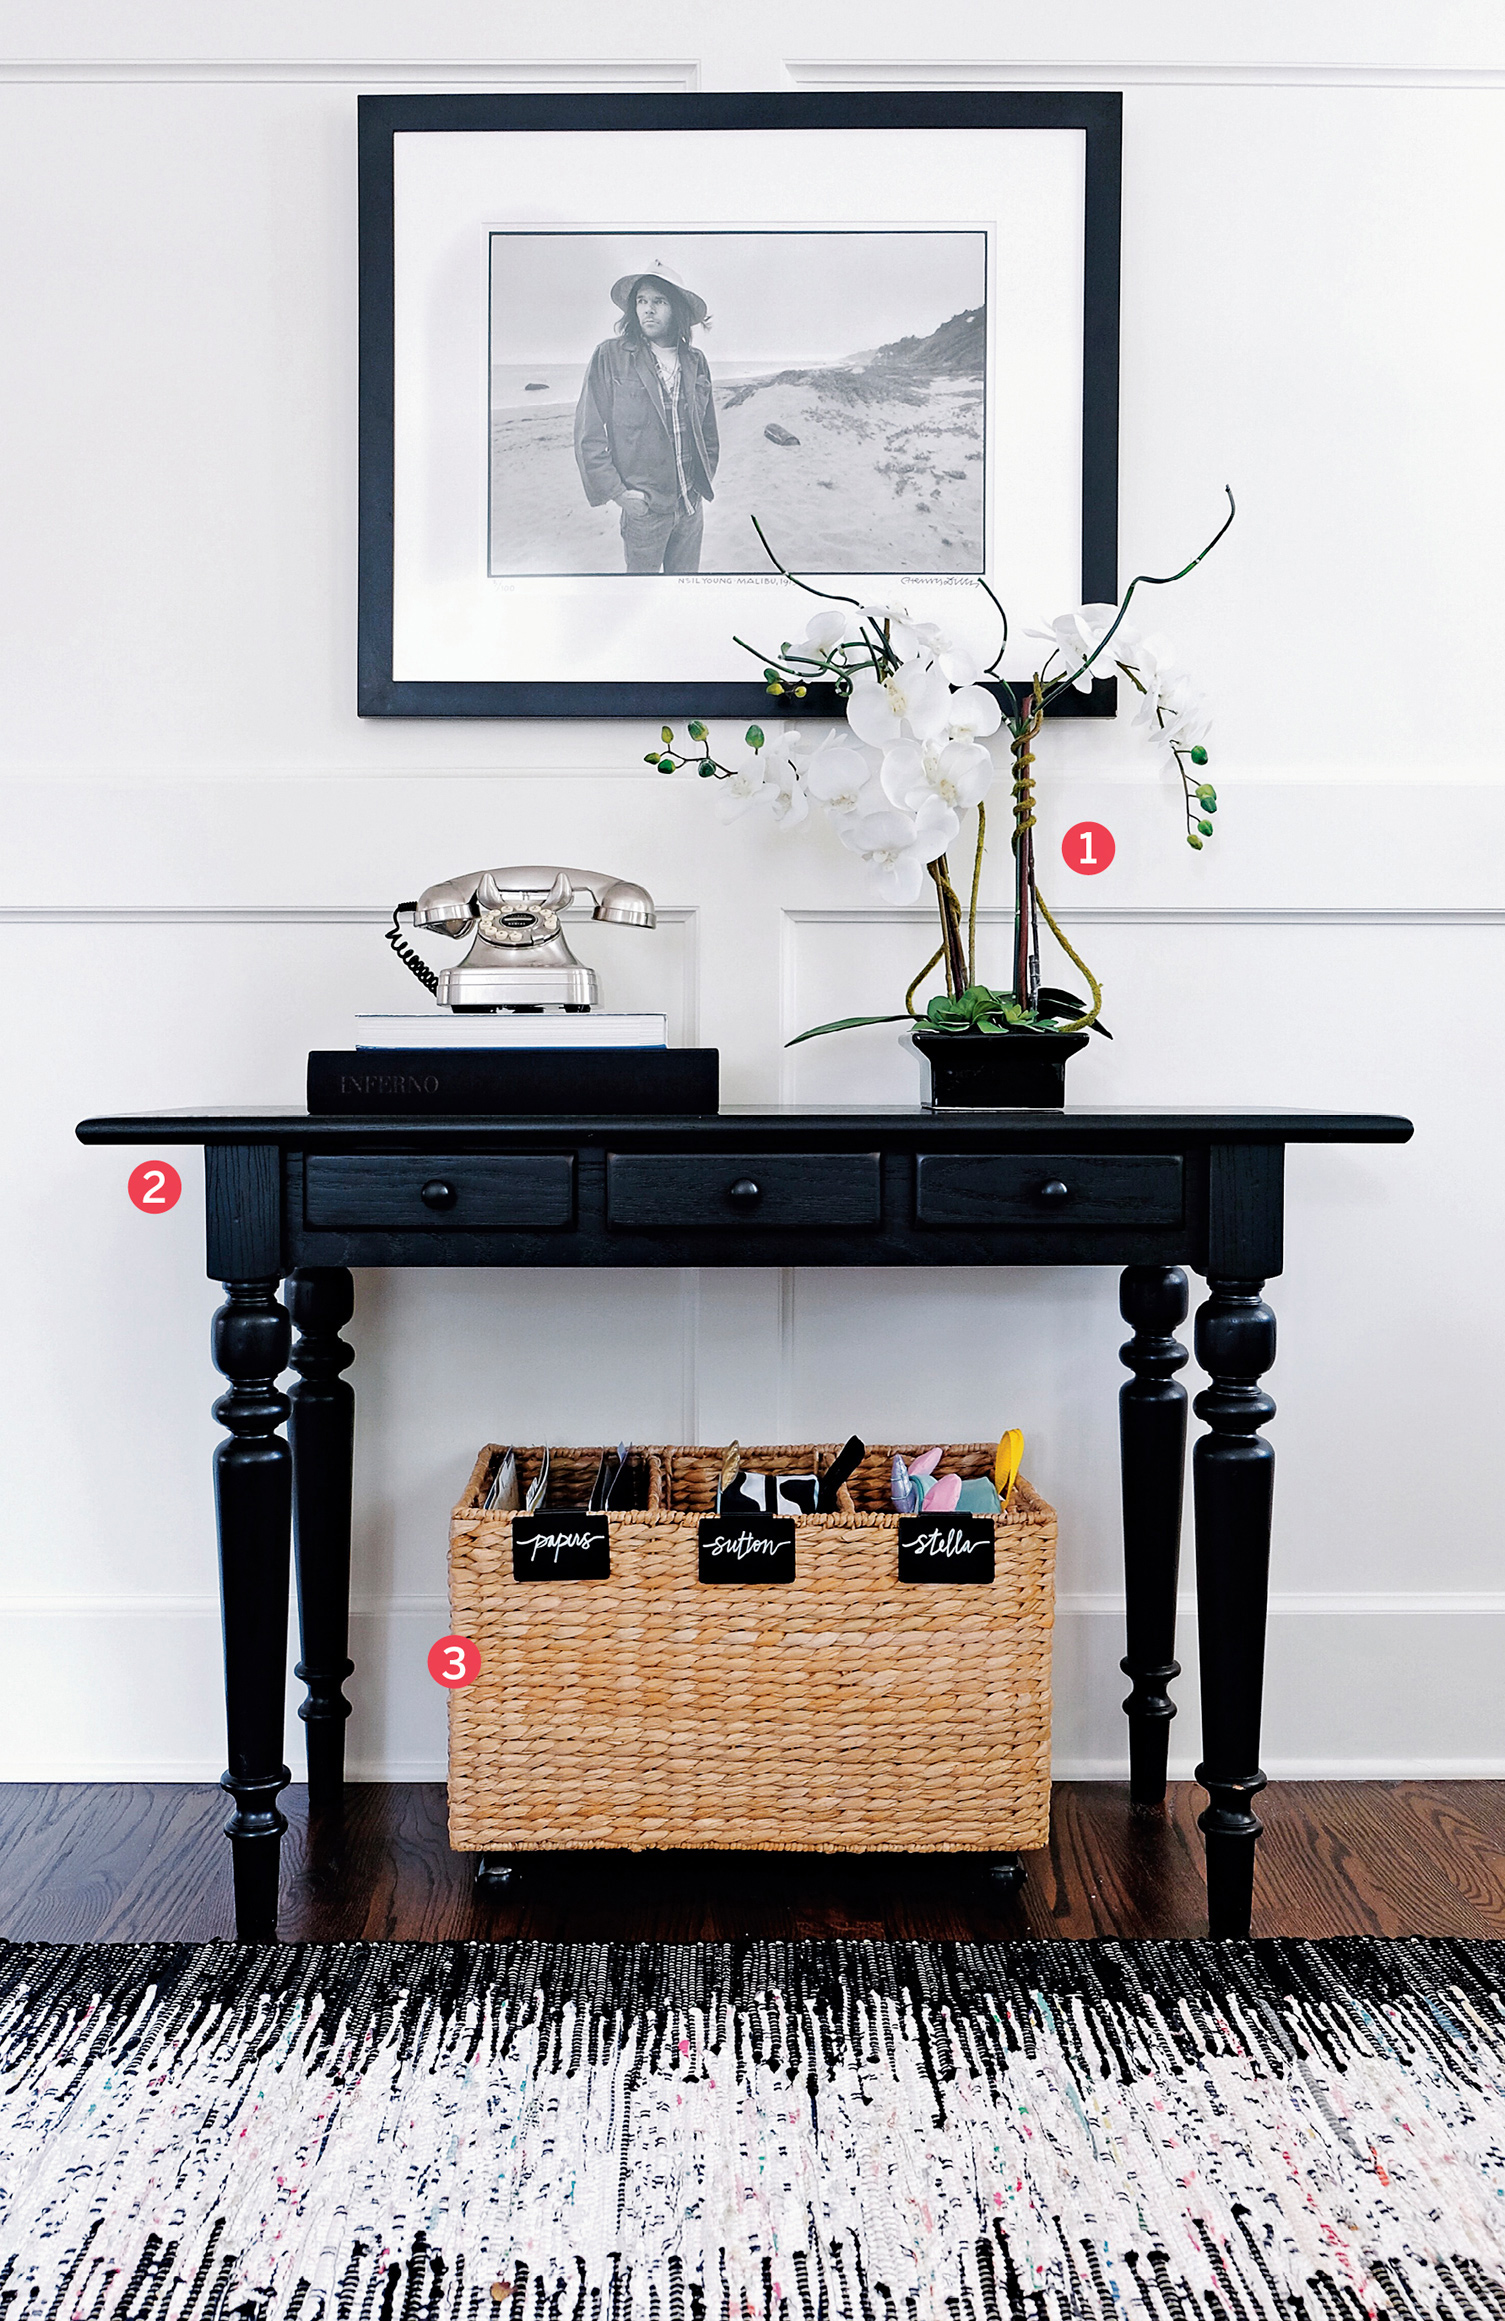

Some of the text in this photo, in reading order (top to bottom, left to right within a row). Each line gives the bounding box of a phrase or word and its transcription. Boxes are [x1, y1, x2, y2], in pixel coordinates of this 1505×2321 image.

[339, 1074, 440, 1094] INFERNO
[702, 1530, 791, 1560] sutton
[901, 1527, 990, 1558] stella
